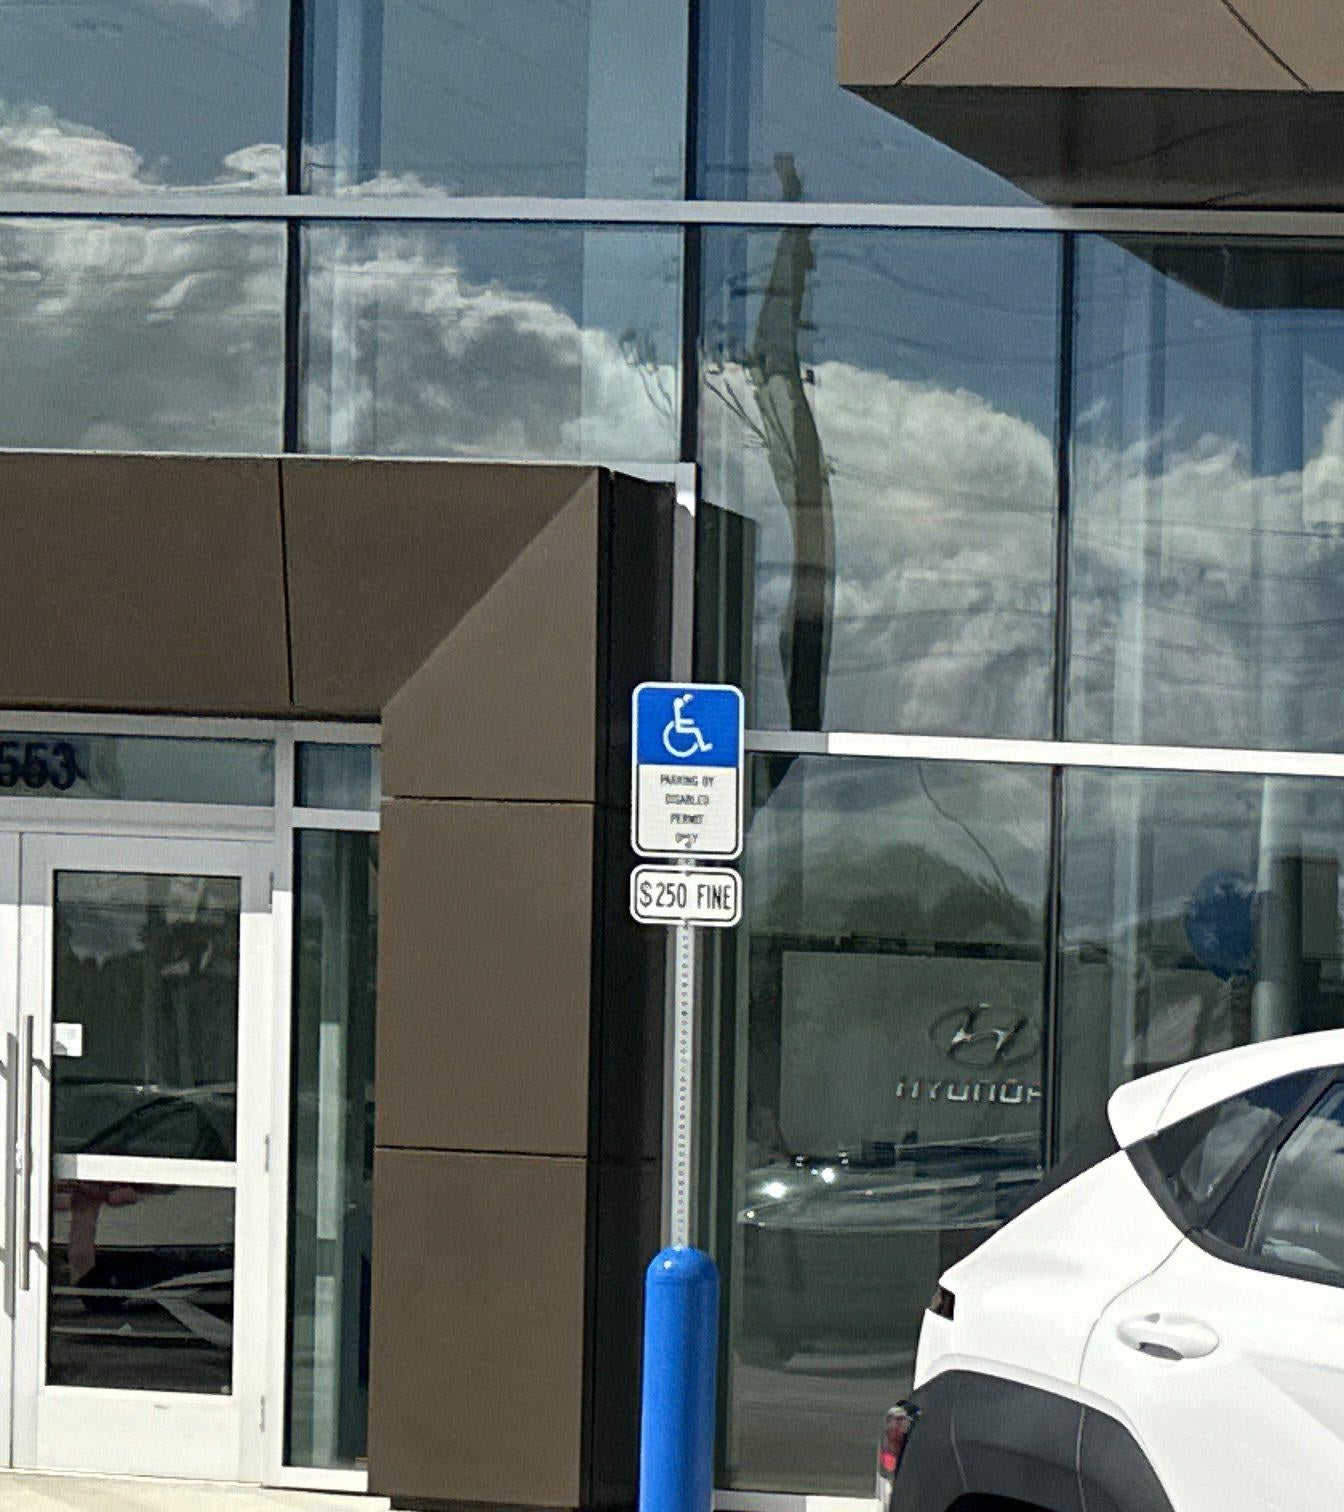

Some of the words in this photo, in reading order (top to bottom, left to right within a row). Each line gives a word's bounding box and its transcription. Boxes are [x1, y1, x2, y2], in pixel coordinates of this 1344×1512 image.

[659, 773, 698, 787] PARKING
[701, 774, 715, 788] BY
[665, 793, 710, 806] DISABLED
[670, 813, 704, 825] PERMIT
[639, 880, 687, 908] $250
[697, 884, 732, 910] FINE
